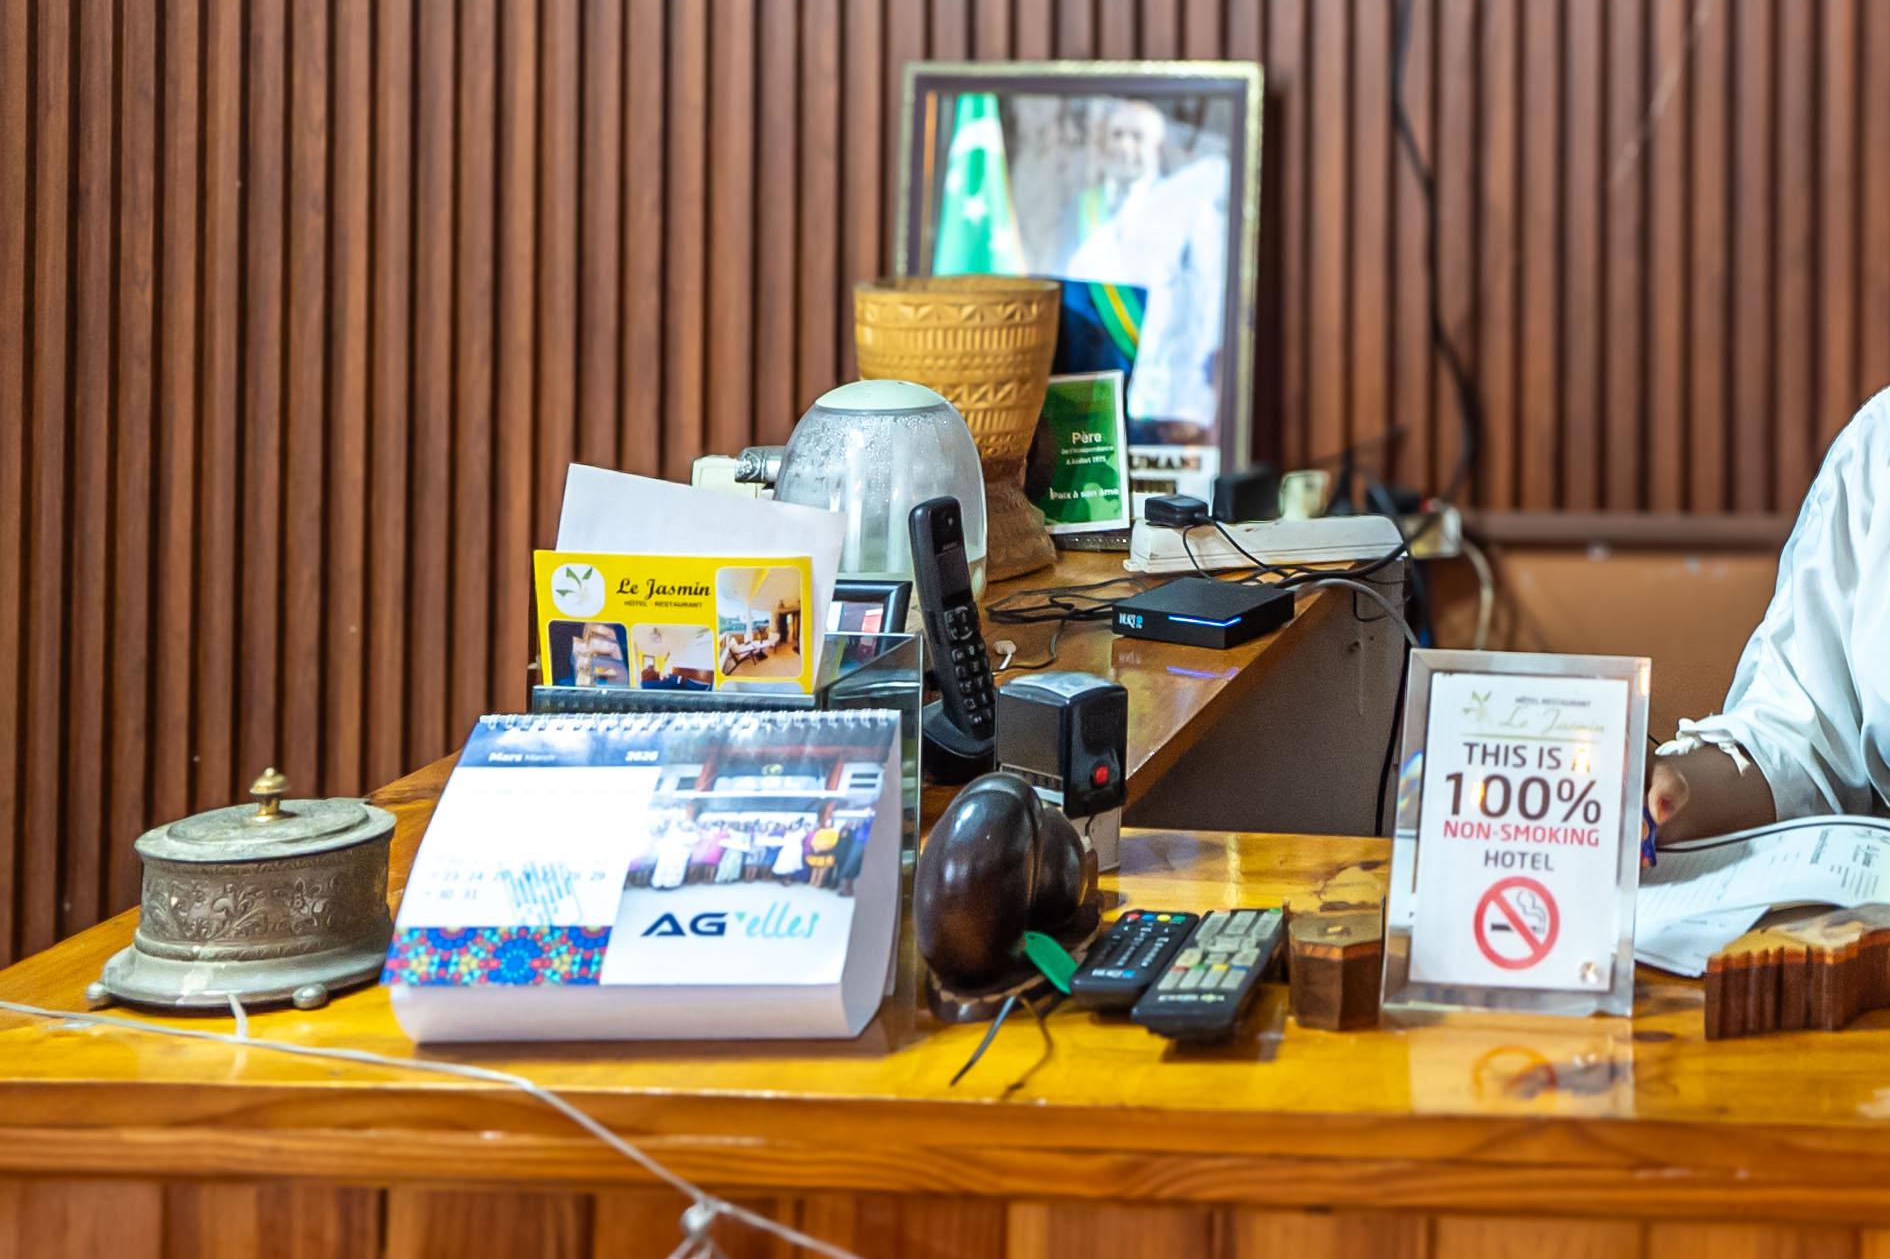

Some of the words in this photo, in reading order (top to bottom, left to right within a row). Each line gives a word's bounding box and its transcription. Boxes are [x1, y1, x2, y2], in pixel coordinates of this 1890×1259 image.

[1072, 431, 1102, 444] Père
[616, 578, 639, 595] Le
[645, 578, 711, 600] Jasmin
[1463, 742, 1527, 768] THIS
[1537, 746, 1562, 770] IS
[1445, 772, 1602, 825] 100%
[1443, 820, 1600, 847] NON-SMOKING
[1484, 849, 1555, 872] HOTEL
